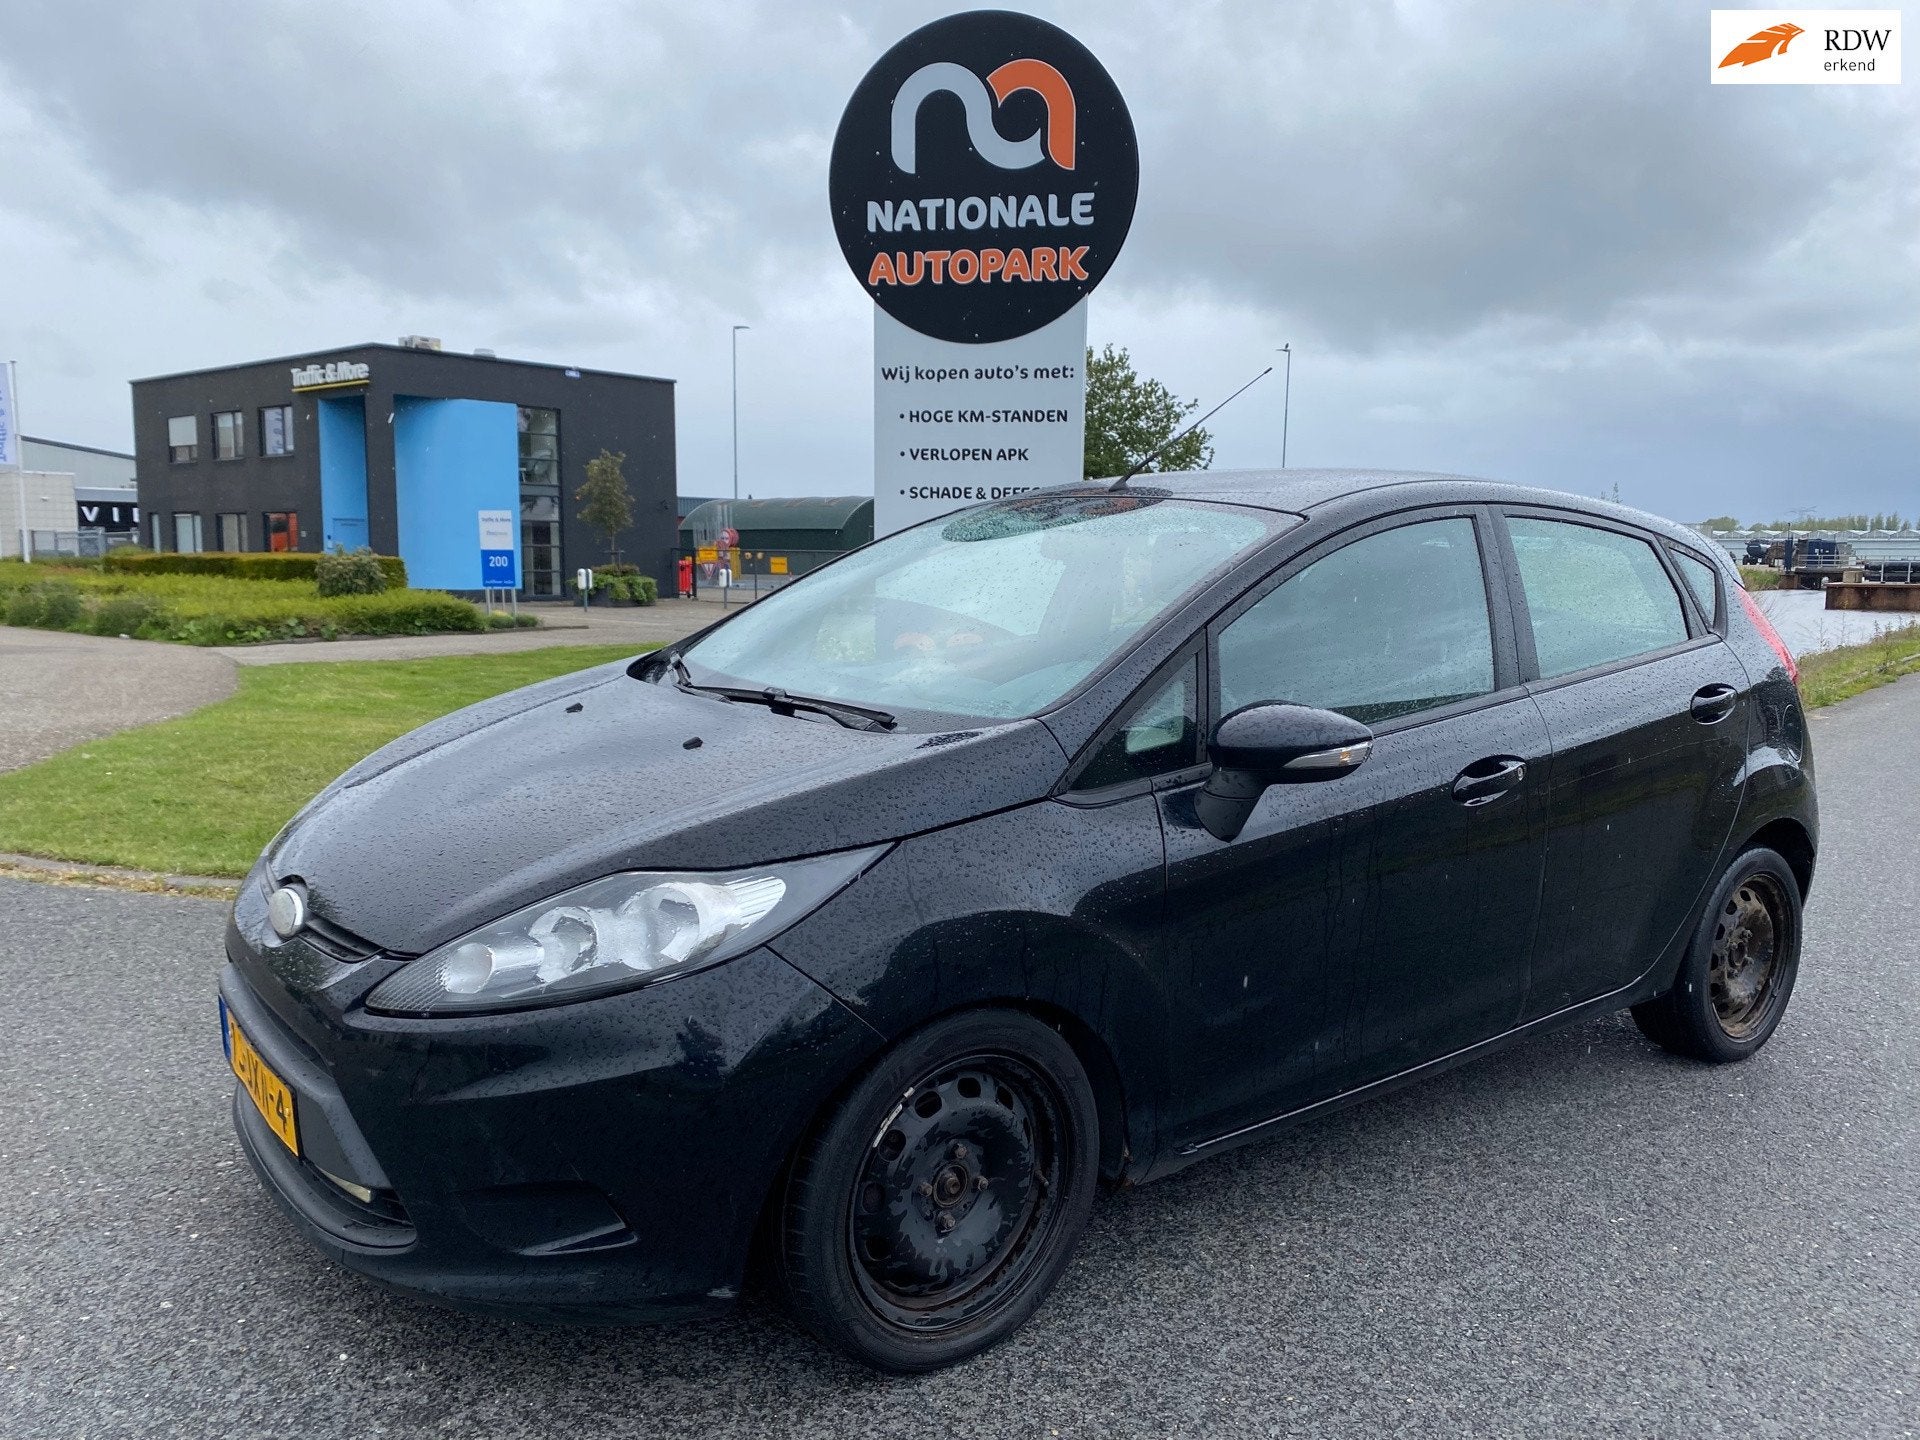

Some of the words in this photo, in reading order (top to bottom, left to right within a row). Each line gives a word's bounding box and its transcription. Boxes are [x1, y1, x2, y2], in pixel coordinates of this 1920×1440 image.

[866, 192, 1096, 233] NATIONALE
[868, 246, 1090, 286] AUTOPARK
[881, 365, 910, 383] Wij
[914, 365, 970, 382] kopen
[973, 365, 1029, 380] auto's
[1033, 365, 1075, 379] met:
[909, 409, 954, 423] HOGE
[957, 409, 1069, 423] KM-STANDEN
[909, 448, 993, 461] VERLOPEN
[996, 448, 1030, 461] APK
[909, 486, 973, 499] SCHADE
[975, 486, 987, 500] &
[990, 486, 1041, 500] DEF
[488, 555, 509, 568] 200
